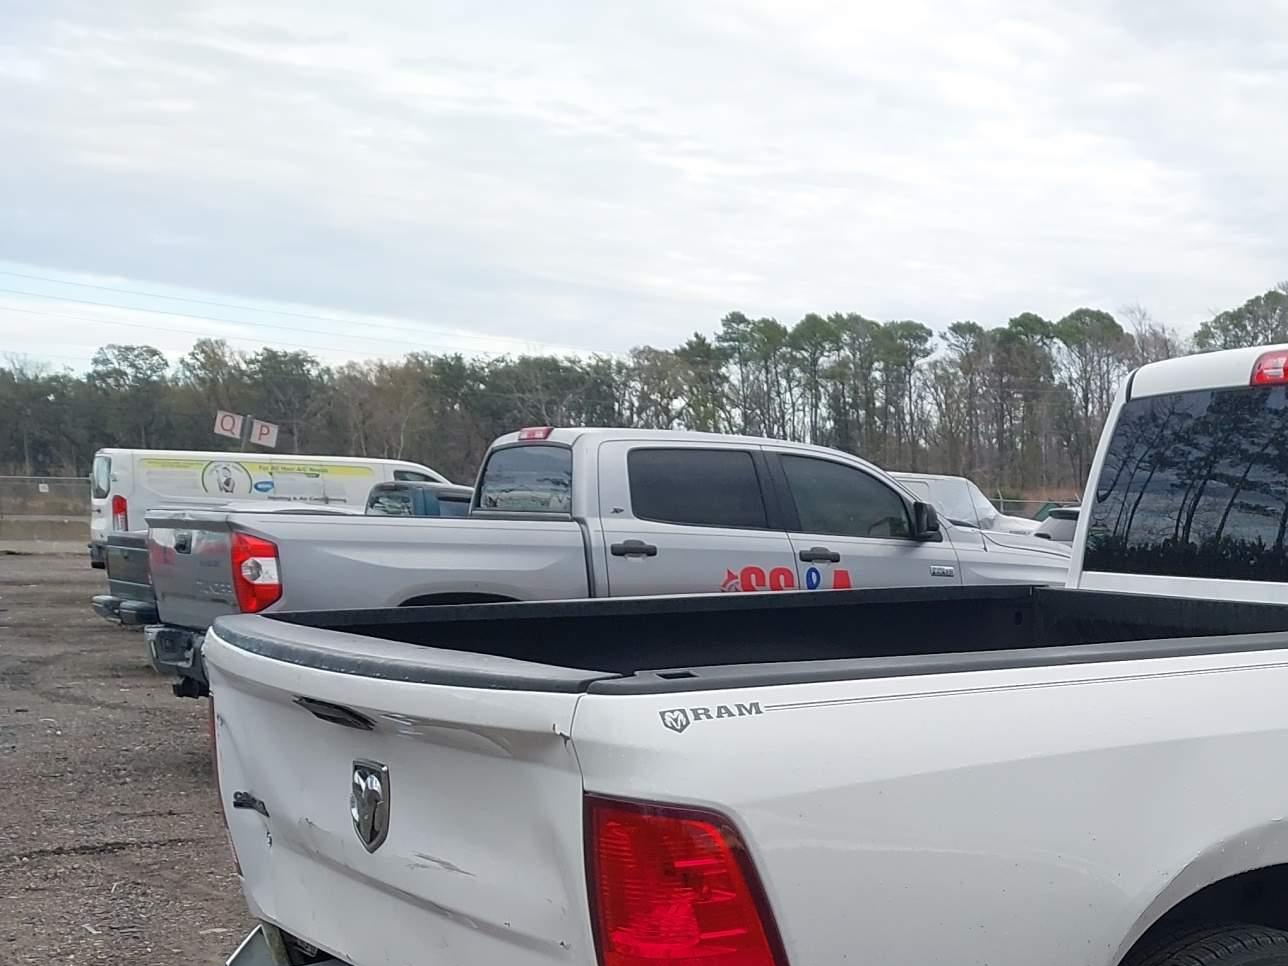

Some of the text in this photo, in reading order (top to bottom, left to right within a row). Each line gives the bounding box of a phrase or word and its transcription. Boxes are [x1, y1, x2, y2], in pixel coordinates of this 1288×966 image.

[220, 414, 236, 435] Q
[258, 424, 270, 440] P
[689, 702, 764, 721] RAM
